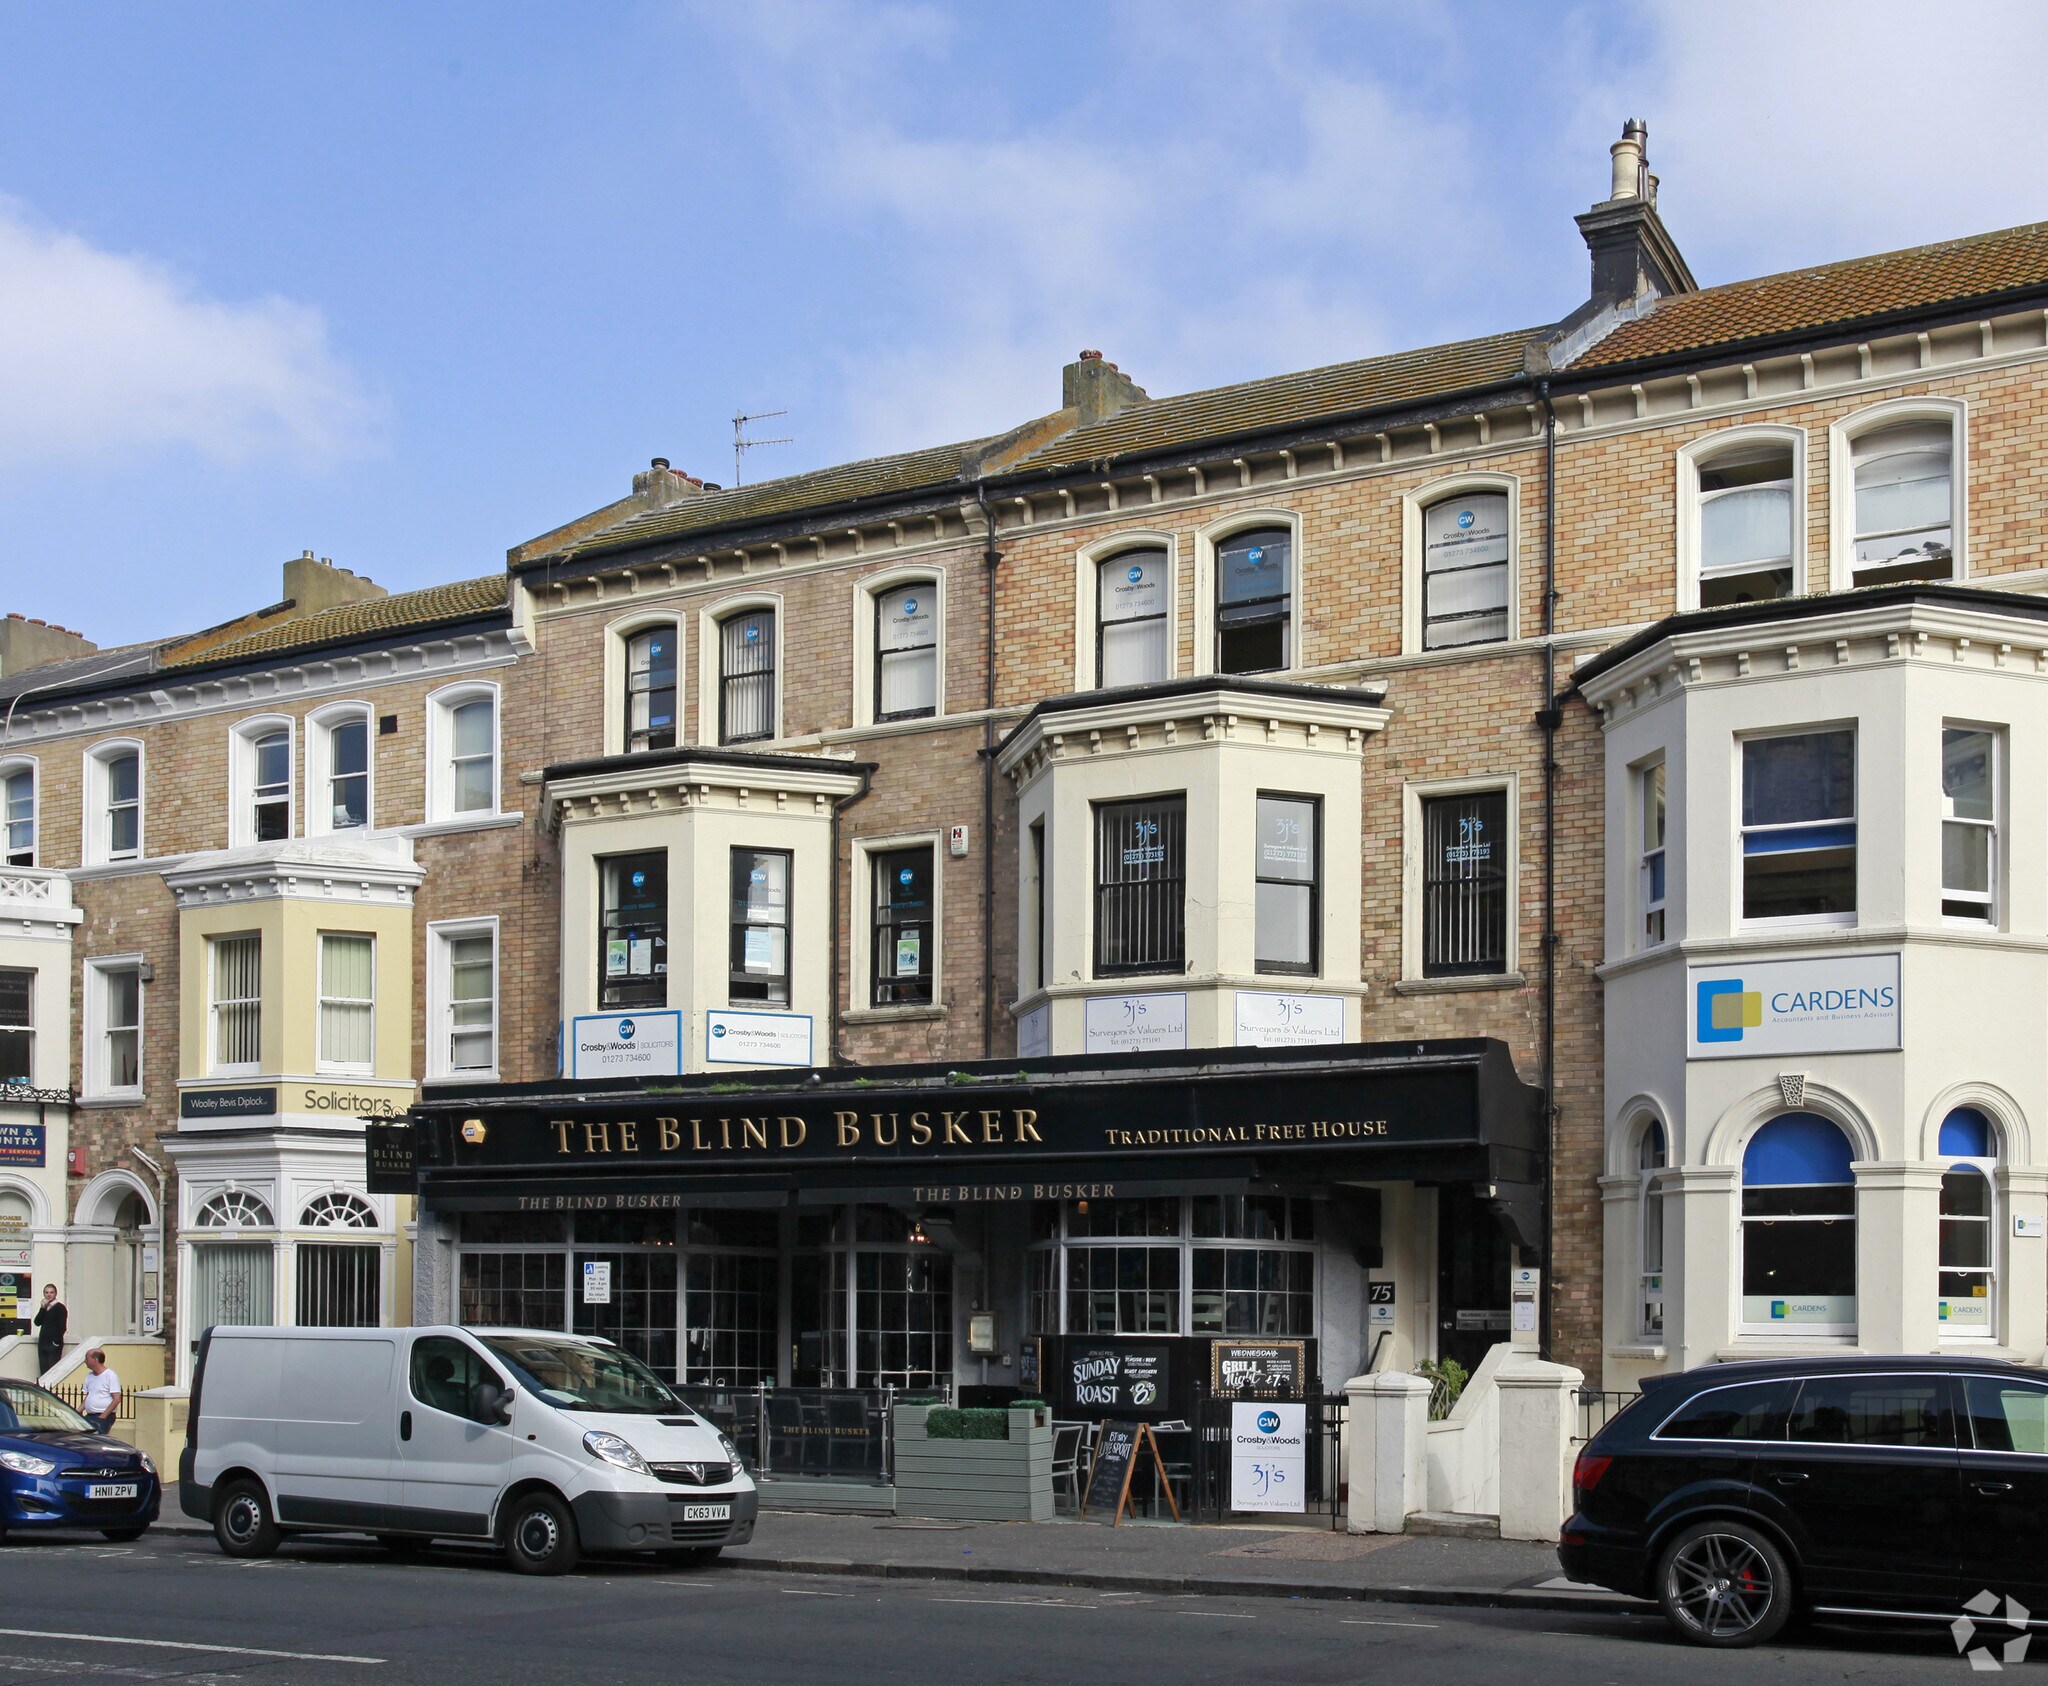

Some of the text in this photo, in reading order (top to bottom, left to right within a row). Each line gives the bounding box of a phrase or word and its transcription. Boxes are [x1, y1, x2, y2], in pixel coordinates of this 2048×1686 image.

[1458, 515, 1474, 524] CW
[1249, 550, 1263, 559] CW
[1128, 570, 1142, 579] CW
[904, 602, 917, 610] CW
[633, 875, 645, 883] CW
[752, 873, 767, 881] CW
[900, 873, 914, 881] CW
[1771, 986, 1895, 1014] CARDENS
[1122, 999, 1147, 1027] 3j's
[1276, 998, 1304, 1026] 3j's
[1772, 1015, 1814, 1023] Accountants
[1816, 1013, 1829, 1021] and
[619, 1024, 634, 1034] CW
[712, 1027, 726, 1035] CW
[1089, 1028, 1128, 1038] Surveyors
[1137, 1024, 1167, 1035] Valuers
[1168, 1022, 1183, 1033] Ltd
[1239, 1022, 1340, 1037] Surveyors & Valuers Ltd
[641, 1040, 674, 1049] SOLICITORS
[738, 1040, 782, 1049] 01273 734600
[602, 1053, 652, 1064] 01273 734600
[190, 1096, 263, 1110] Woolley Bevis Diplock
[304, 1089, 392, 1112] Solicitors
[25, 1128, 33, 1136] &
[550, 1108, 1043, 1153] THE BLIND BUSKER
[1105, 1120, 1388, 1145] TRADITIONAL FREE HOUSE
[373, 1149, 413, 1159] BLIND
[375, 1160, 411, 1169] BUSKER
[912, 1184, 1114, 1201] THE BLIND BUSKER
[518, 1194, 681, 1209] THE BLIND BUSKER
[1371, 1285, 1392, 1301] 75
[1791, 1304, 1827, 1312] CARDENS
[1953, 1306, 1983, 1314] CARDENS
[145, 1316, 154, 1326] 81
[1230, 1349, 1278, 1357] WEDNESDAY
[1073, 1357, 1121, 1384] SUNDAY
[1222, 1360, 1262, 1375] GRILL
[1076, 1384, 1120, 1405] ROAST
[1258, 1417, 1279, 1428] CW
[782, 1425, 870, 1436] THE BLIND BUSKER
[1112, 1442, 1133, 1460] SPORT
[1251, 1463, 1286, 1498] 3j's
[115, 1485, 133, 1496] ZPV
[1236, 1499, 1263, 1508] Surveyors
[687, 1507, 709, 1518] CK63
